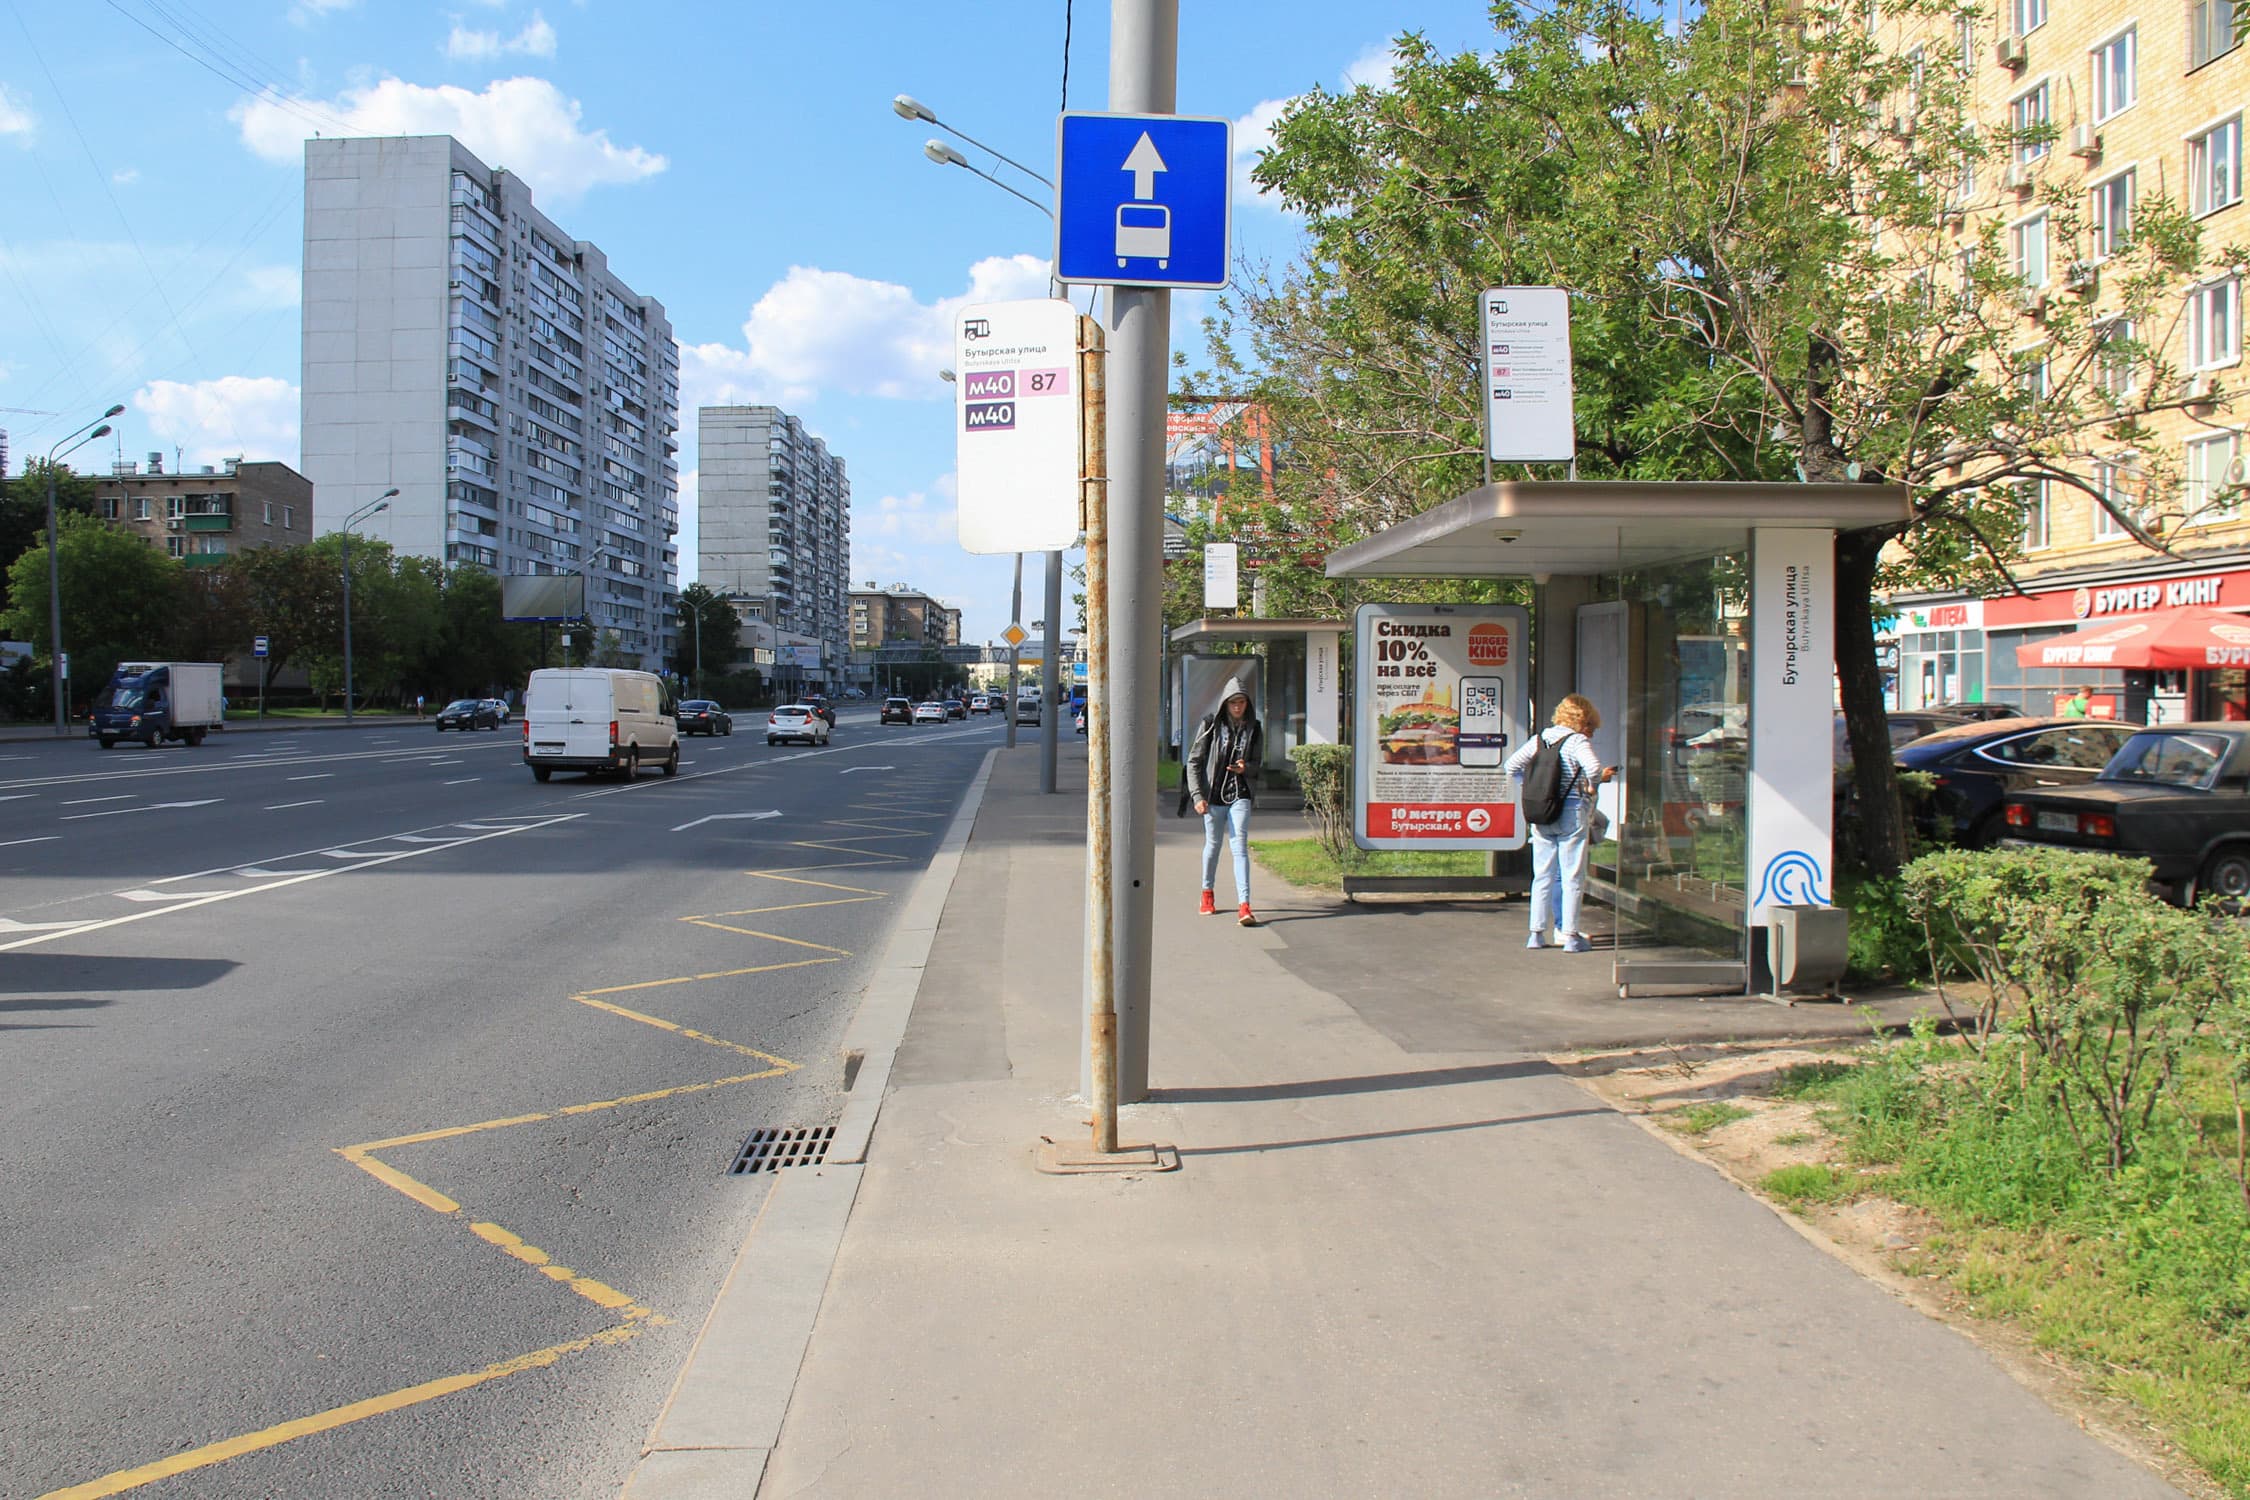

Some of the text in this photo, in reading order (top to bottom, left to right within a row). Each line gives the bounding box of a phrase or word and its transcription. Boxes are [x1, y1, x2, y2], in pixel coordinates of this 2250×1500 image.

[965, 345, 1047, 359] Бутырская улица
[1031, 373, 1057, 391] 87
[2095, 577, 2222, 613] БУРГЕР КИНГ
[1377, 621, 1451, 638] Скидка
[1783, 565, 1799, 685] Бутырская улица
[1468, 636, 1509, 646] BURGER
[1377, 639, 1428, 662] 10%
[1468, 646, 1508, 658] KING
[1377, 661, 1437, 677] на всё
[1391, 808, 1461, 822] 10 метров
[1391, 821, 1462, 832] Бутырская, 6
